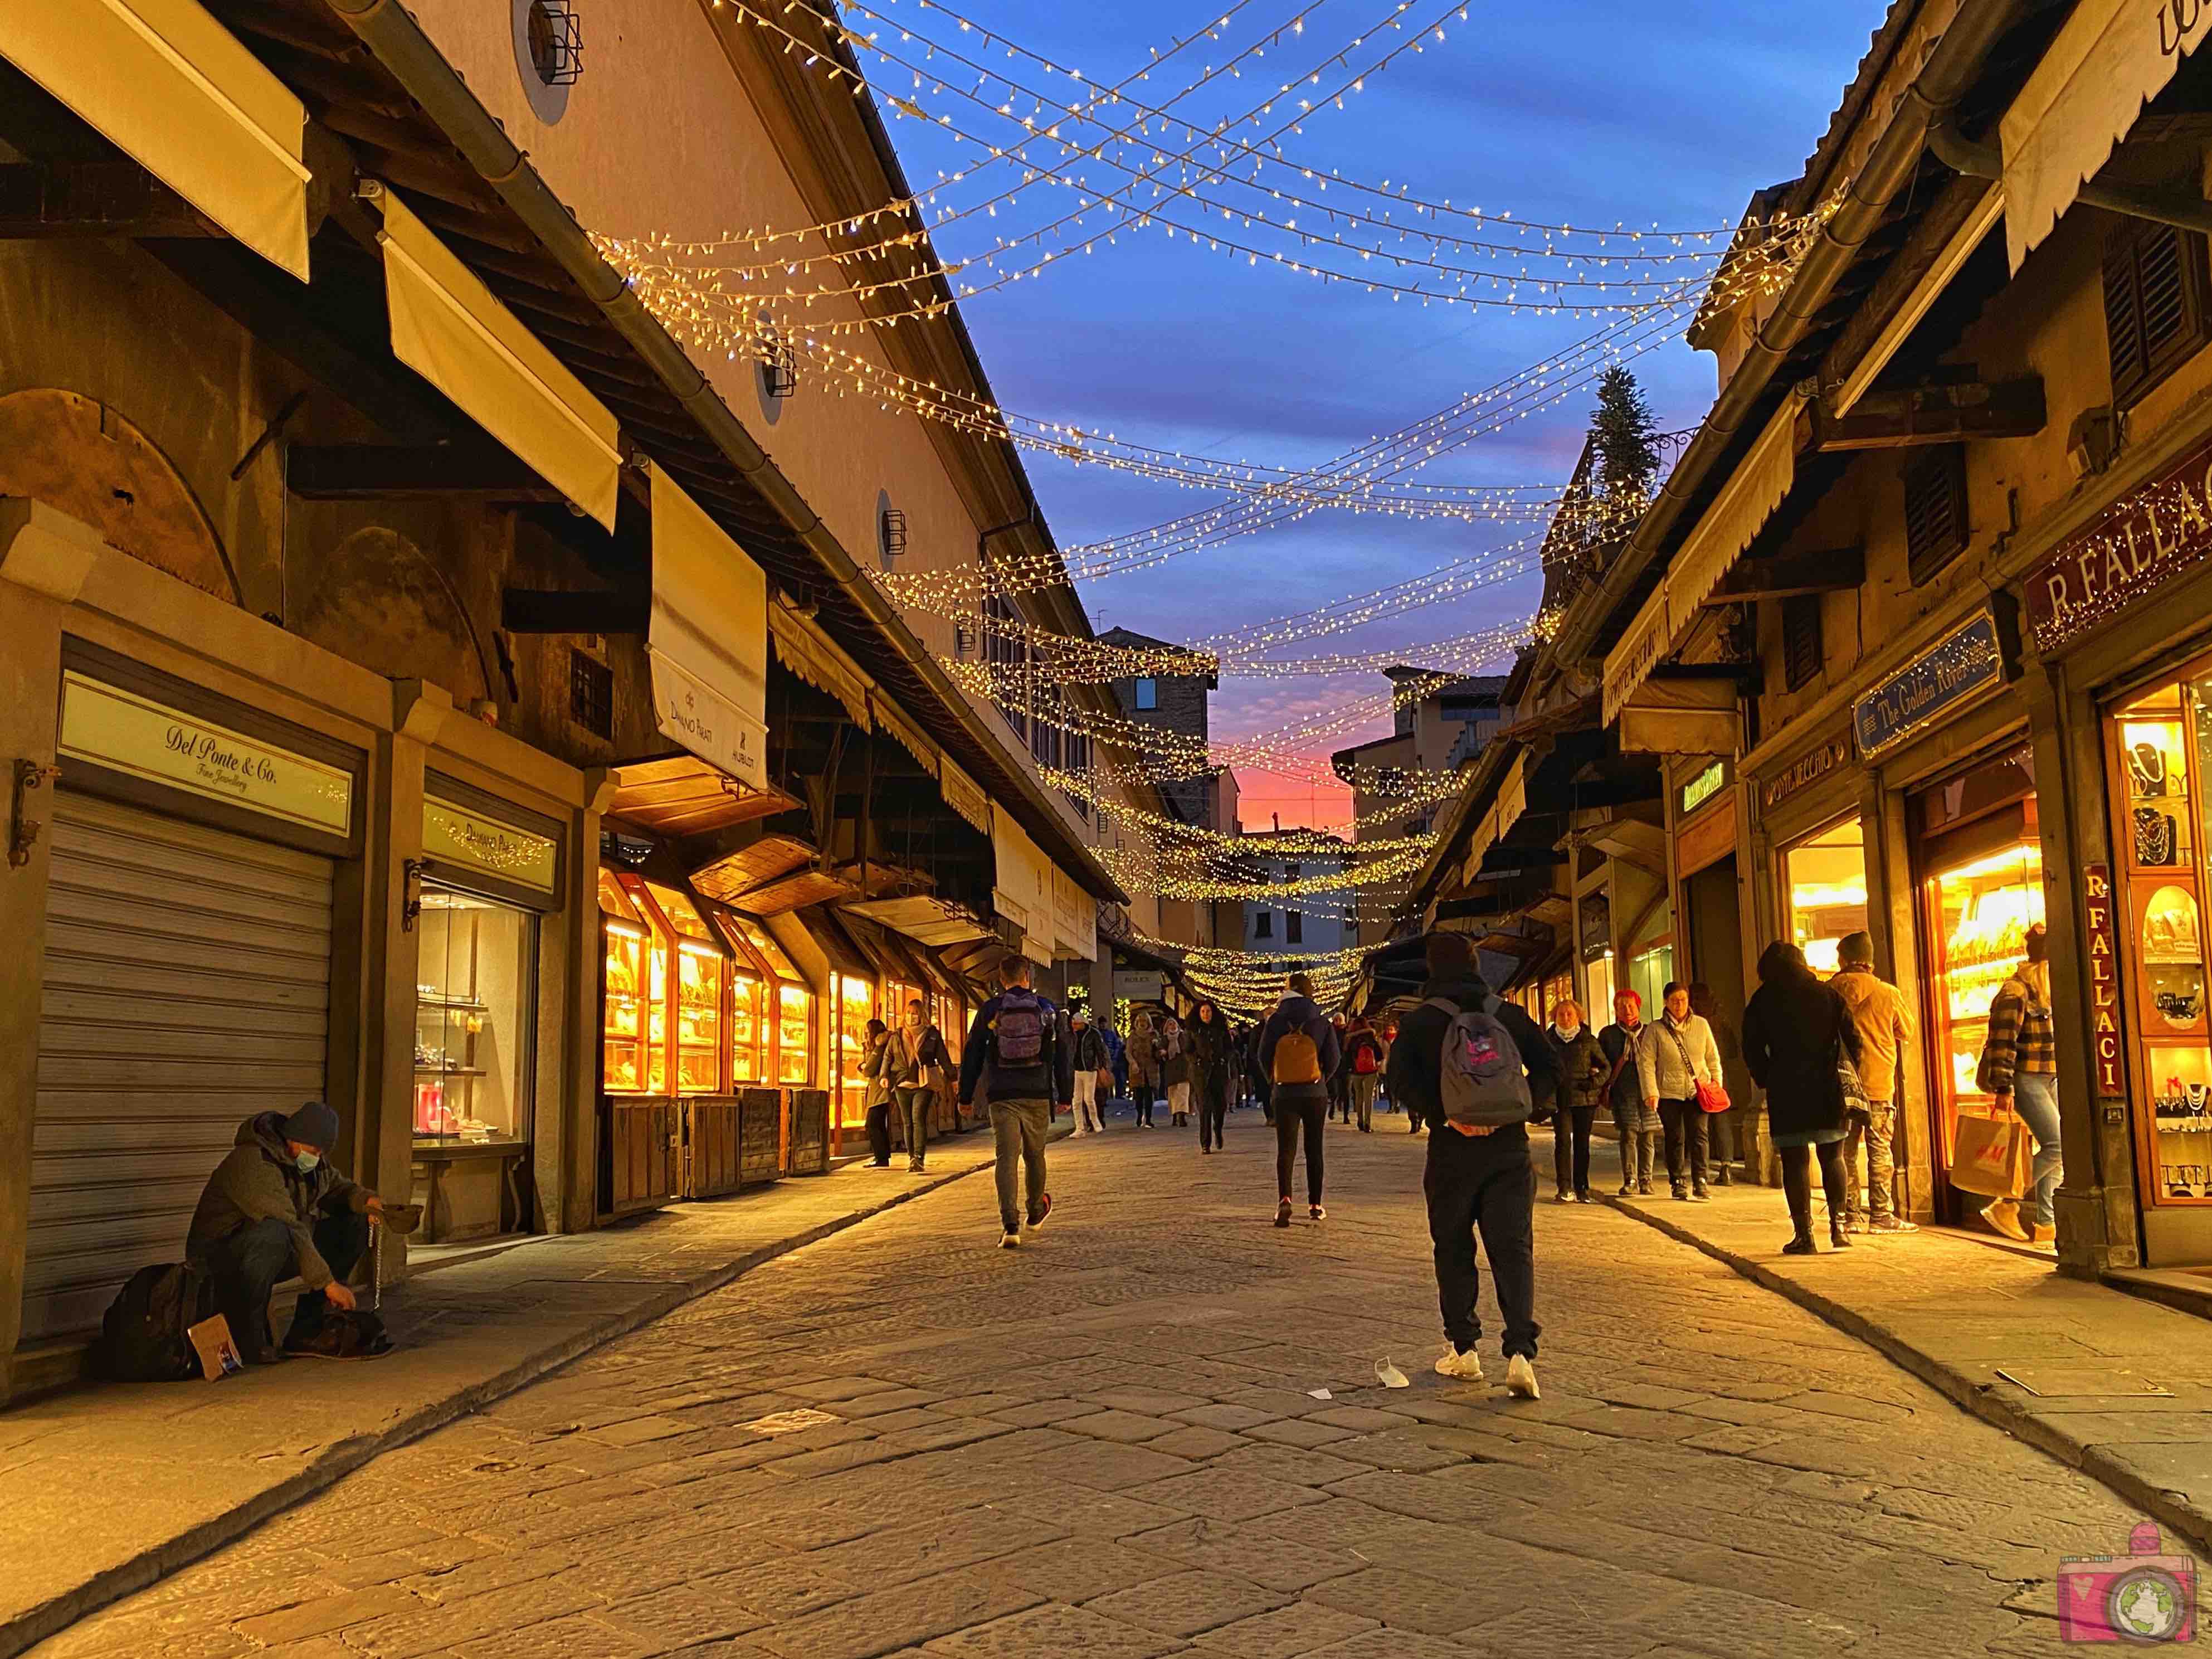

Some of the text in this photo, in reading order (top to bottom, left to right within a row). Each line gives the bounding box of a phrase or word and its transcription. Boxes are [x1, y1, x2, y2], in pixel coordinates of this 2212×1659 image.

[1878, 663, 1967, 729] The Golden River
[165, 726, 277, 784] Del Ponte & Co.
[196, 763, 213, 779] Fine
[2089, 908, 2116, 1085] FALLACI
